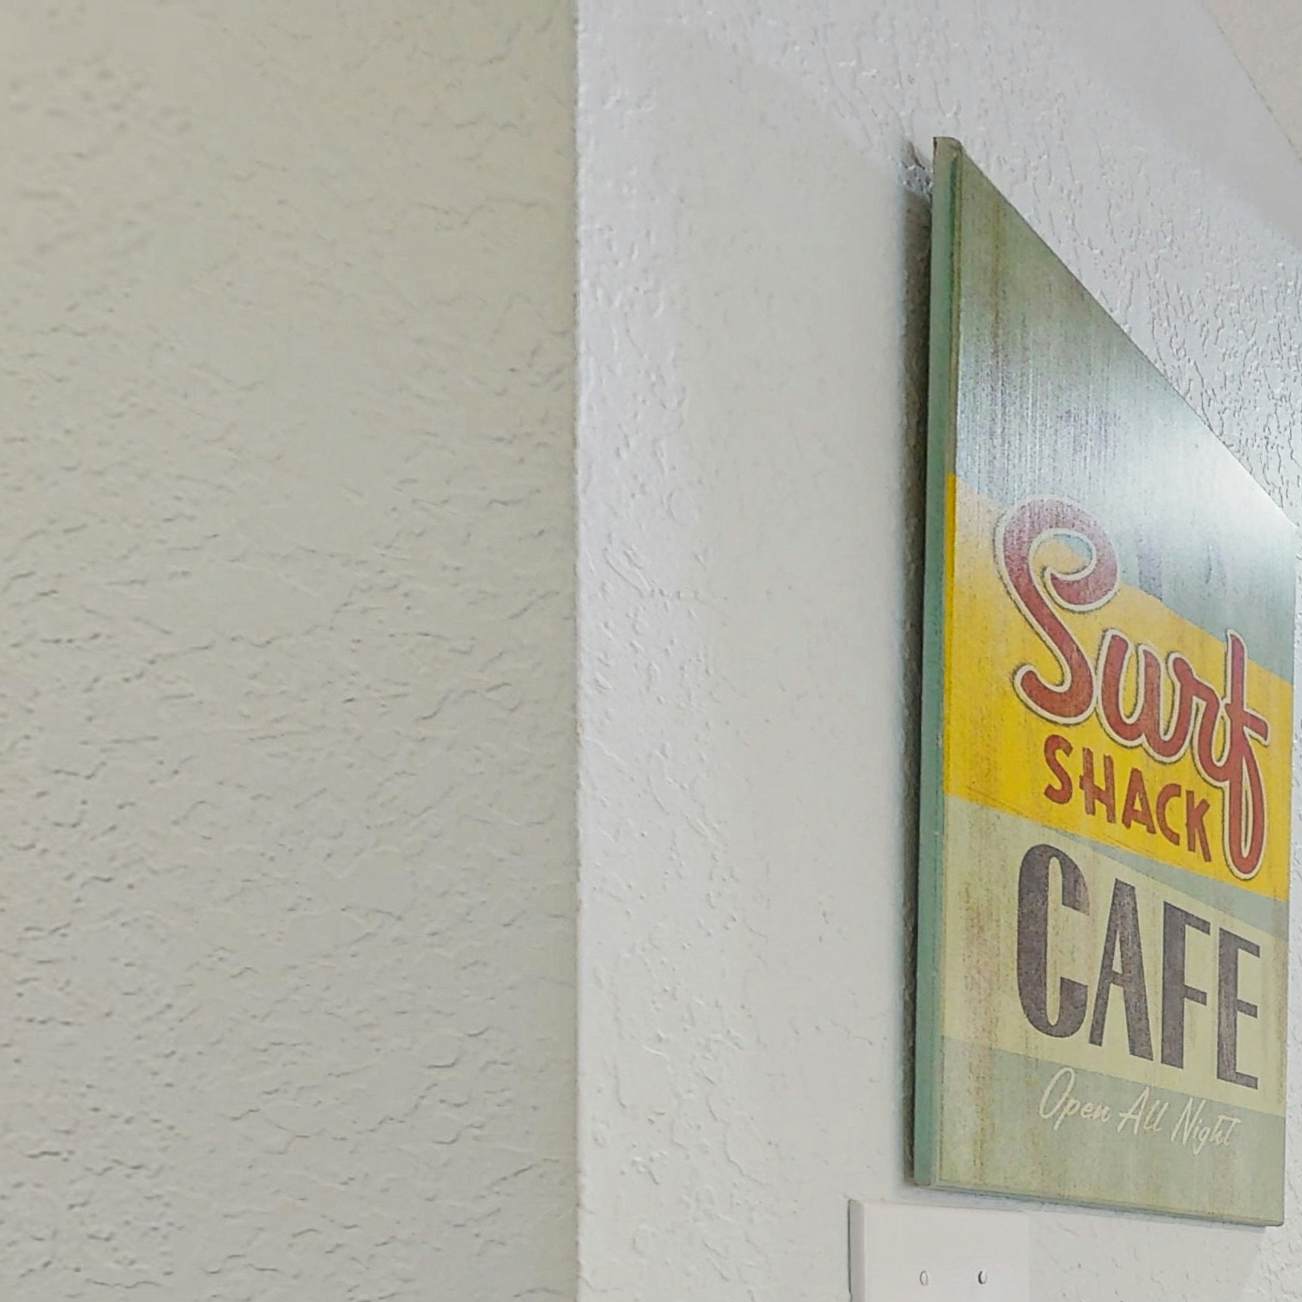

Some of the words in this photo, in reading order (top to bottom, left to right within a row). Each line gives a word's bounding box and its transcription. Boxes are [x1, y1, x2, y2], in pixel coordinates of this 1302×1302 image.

[994, 499, 1269, 881] Surf
[1044, 734, 1211, 862] SHACK
[1018, 843, 1260, 1090] CAFE
[1039, 1067, 1112, 1131] Open
[1117, 1086, 1169, 1135] All
[1171, 1097, 1241, 1155] Night
